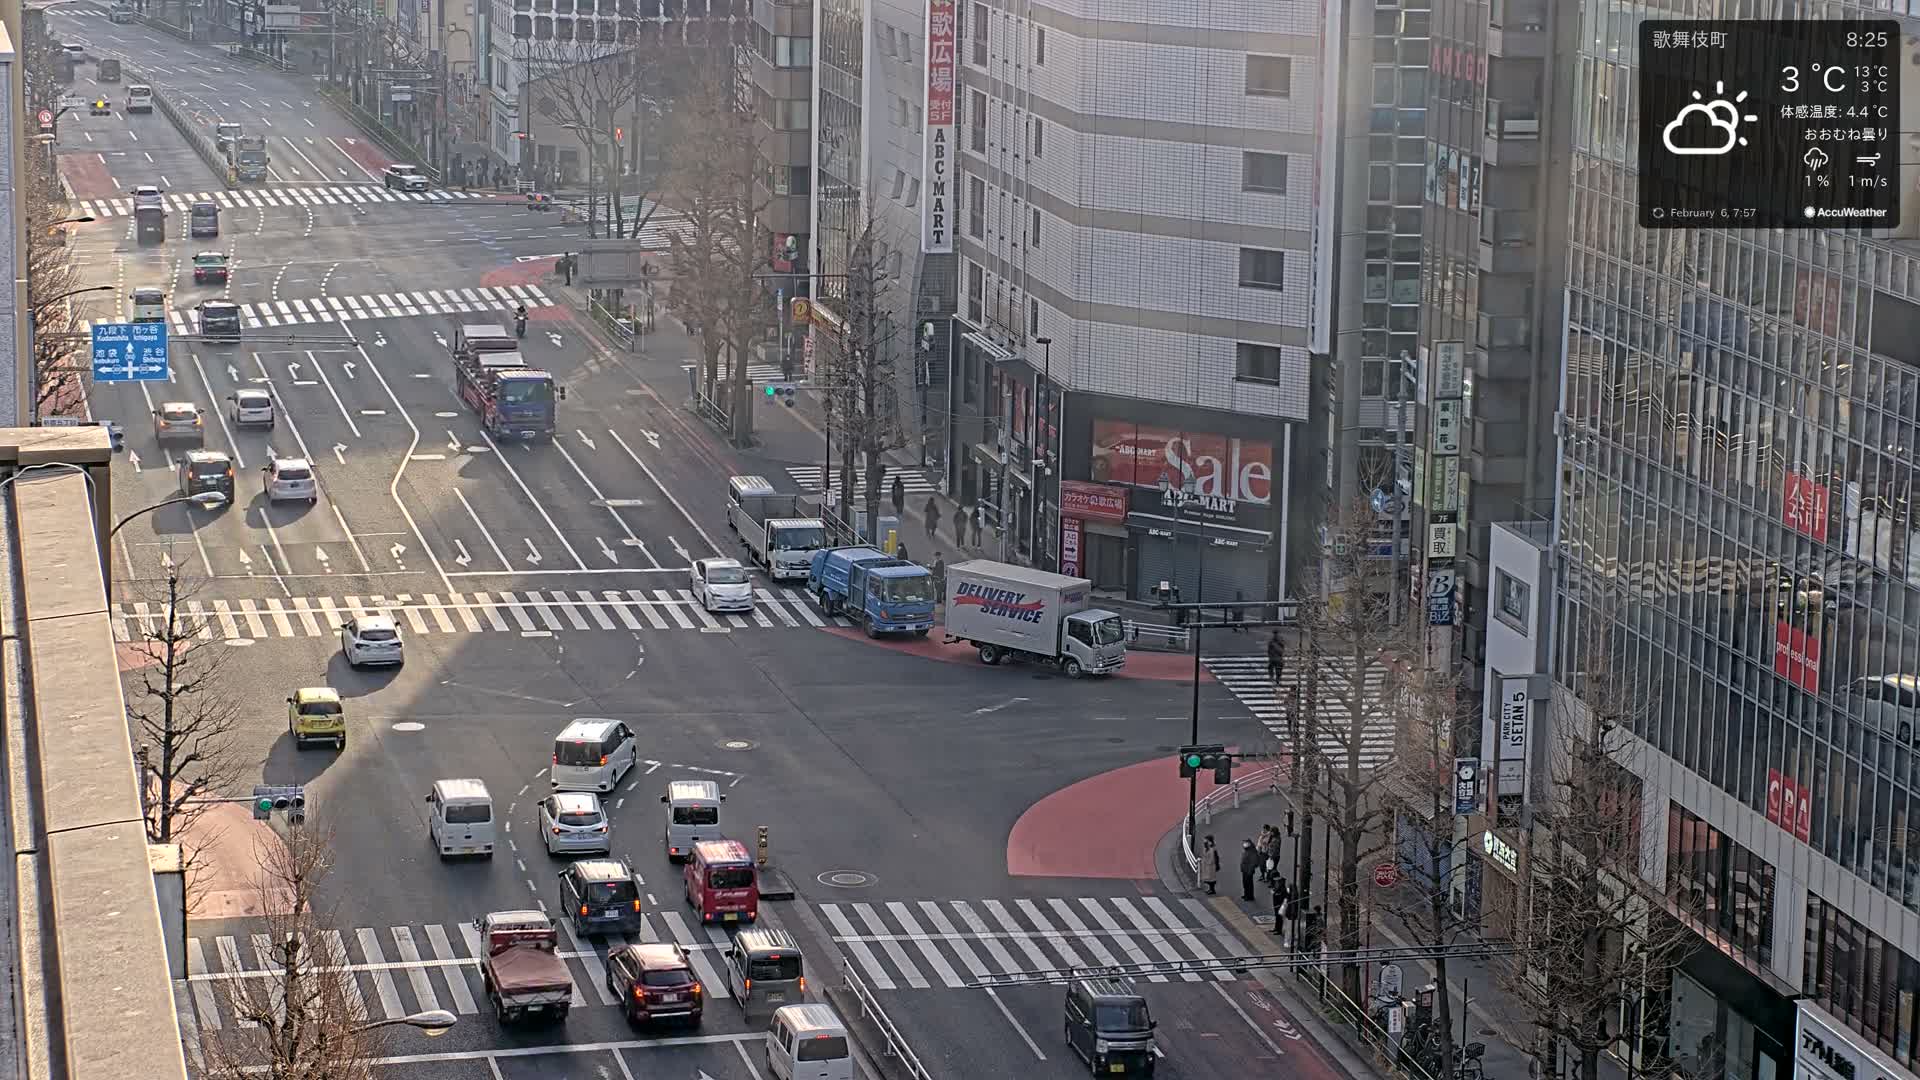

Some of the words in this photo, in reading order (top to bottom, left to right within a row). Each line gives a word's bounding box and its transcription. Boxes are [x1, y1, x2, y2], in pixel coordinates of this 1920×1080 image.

[931, 11, 953, 92] 歌広場
[930, 111, 951, 121] 5F
[933, 128, 945, 244] ABC-MART
[99, 326, 127, 335] 九段下
[1165, 436, 1271, 505] Sale
[1433, 527, 1447, 554] 買取
[956, 581, 1026, 605] DELIVERY
[980, 603, 1044, 624] SERVICE
[1513, 691, 1525, 701] 5
[1504, 702, 1512, 719] CITY
[1503, 721, 1511, 740] PARK
[1512, 705, 1525, 747] ISETAN
